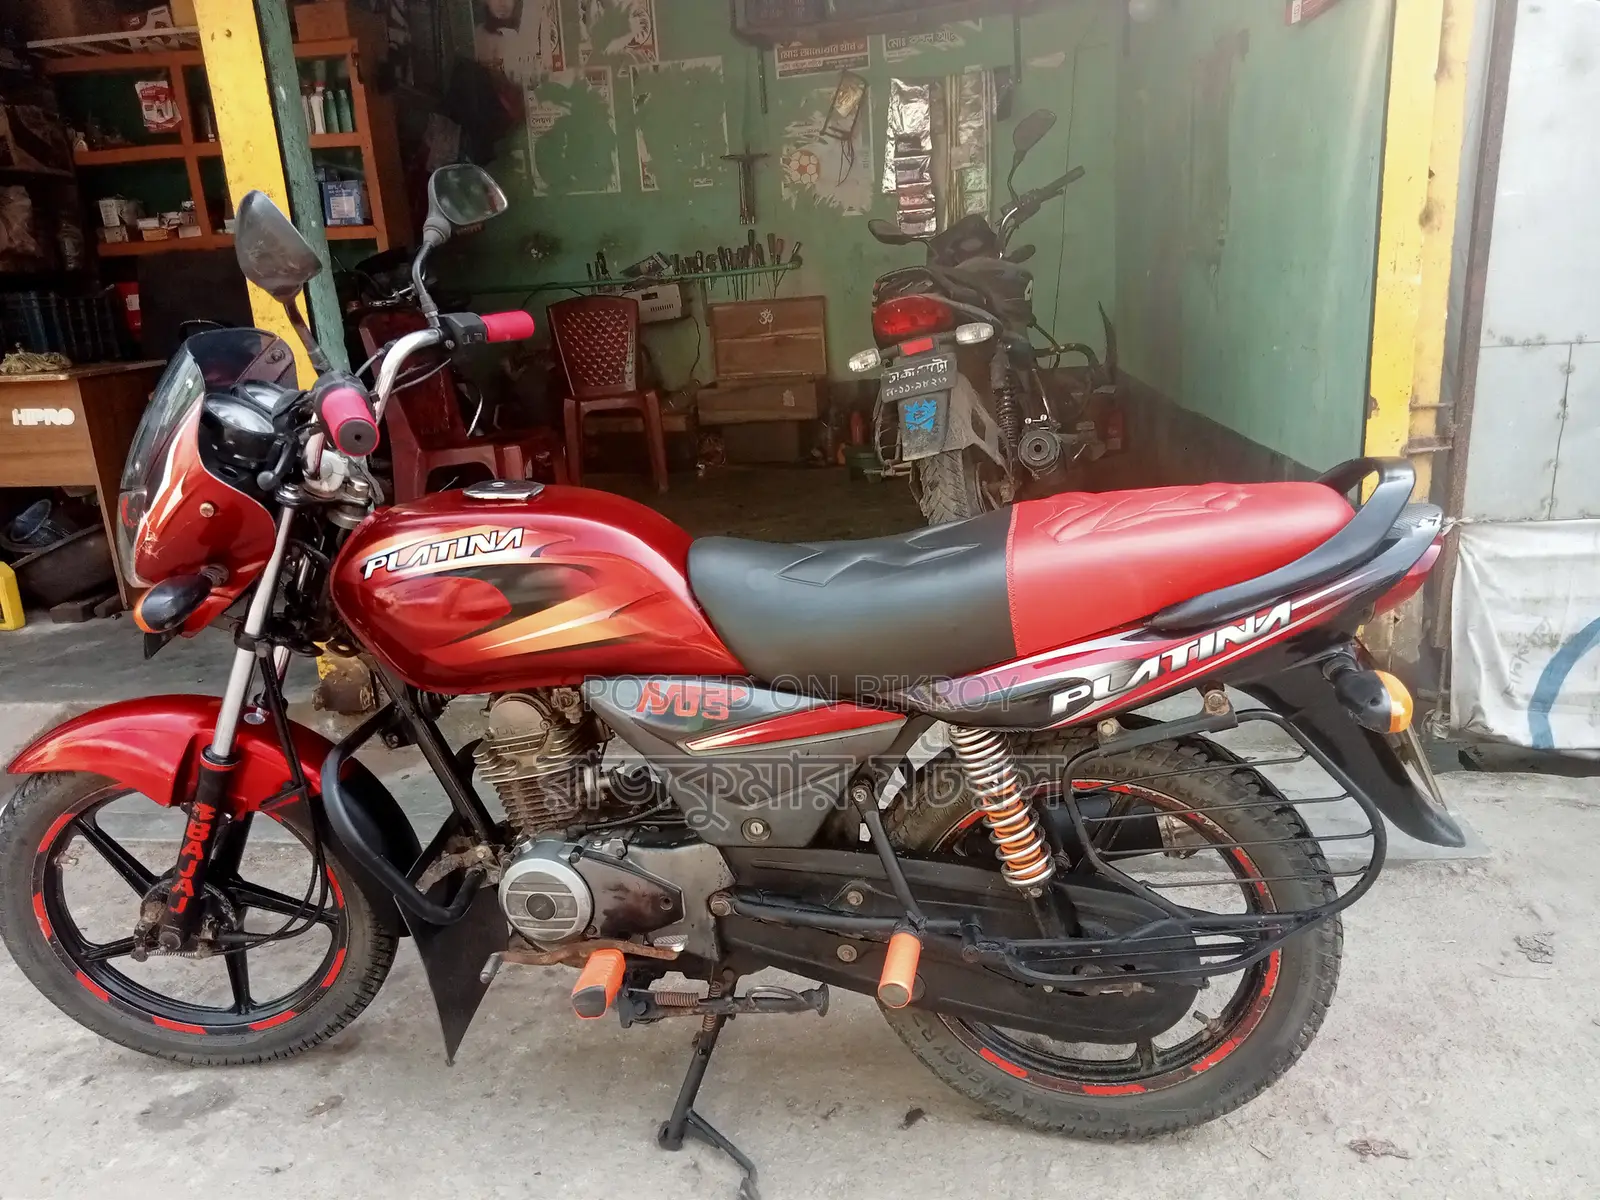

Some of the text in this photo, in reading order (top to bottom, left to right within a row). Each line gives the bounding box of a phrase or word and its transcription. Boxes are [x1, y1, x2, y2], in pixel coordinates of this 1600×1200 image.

[362, 526, 525, 580] PLATINA
[1050, 600, 1292, 717] PLATINA
[169, 820, 212, 914] BAJAJ
